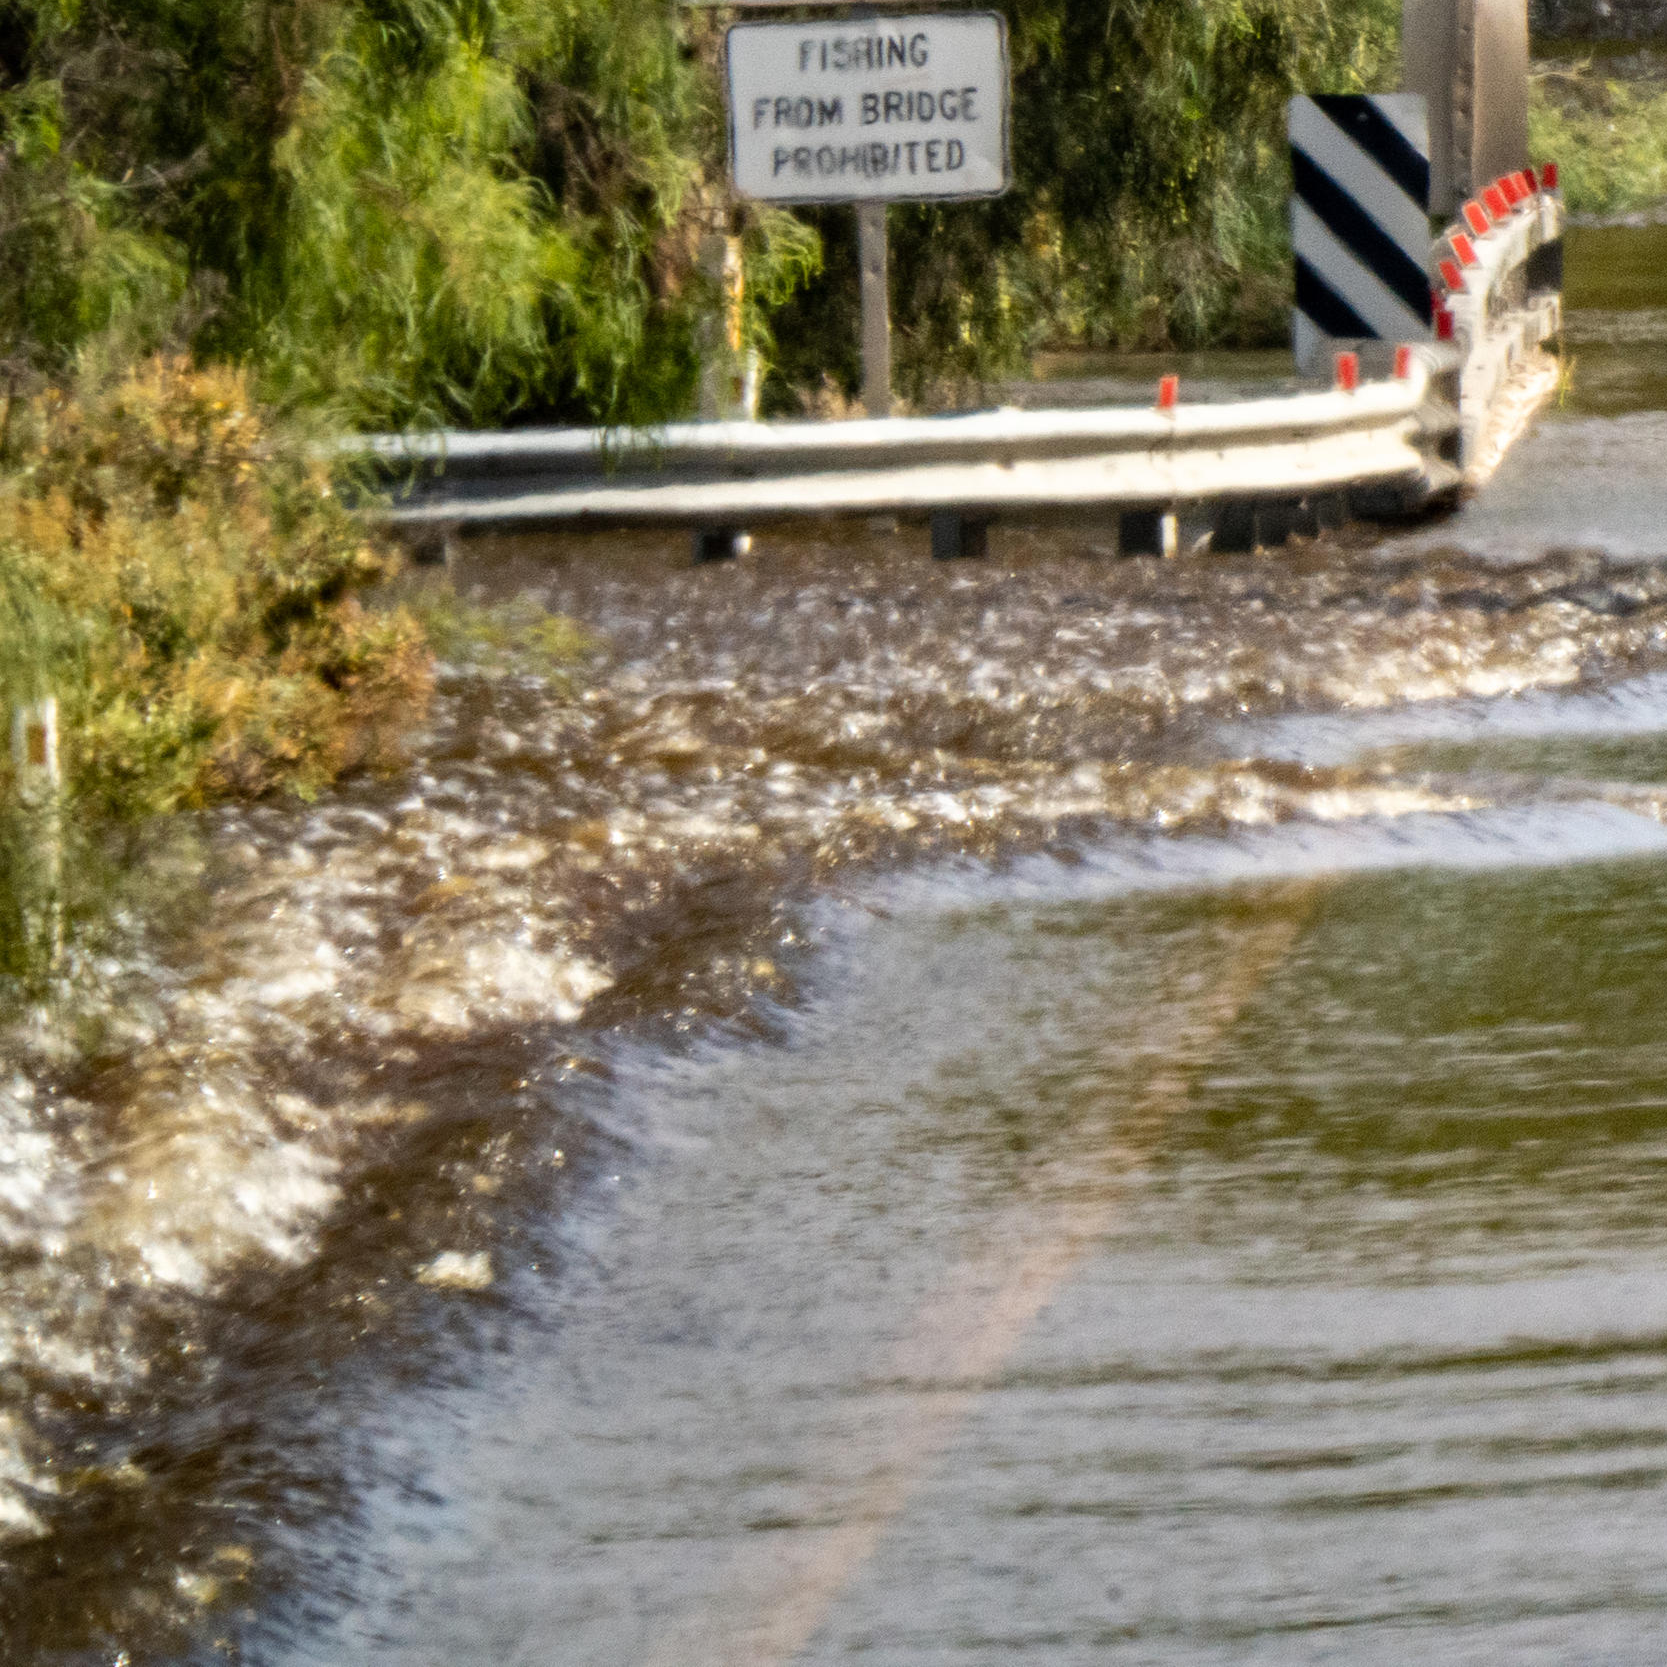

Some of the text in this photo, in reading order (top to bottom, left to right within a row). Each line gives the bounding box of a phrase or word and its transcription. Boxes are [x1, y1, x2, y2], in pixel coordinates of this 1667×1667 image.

[799, 32, 929, 72] FISHING
[752, 86, 979, 130] FROM BRIDGE
[772, 139, 965, 178] PROHIBITED
